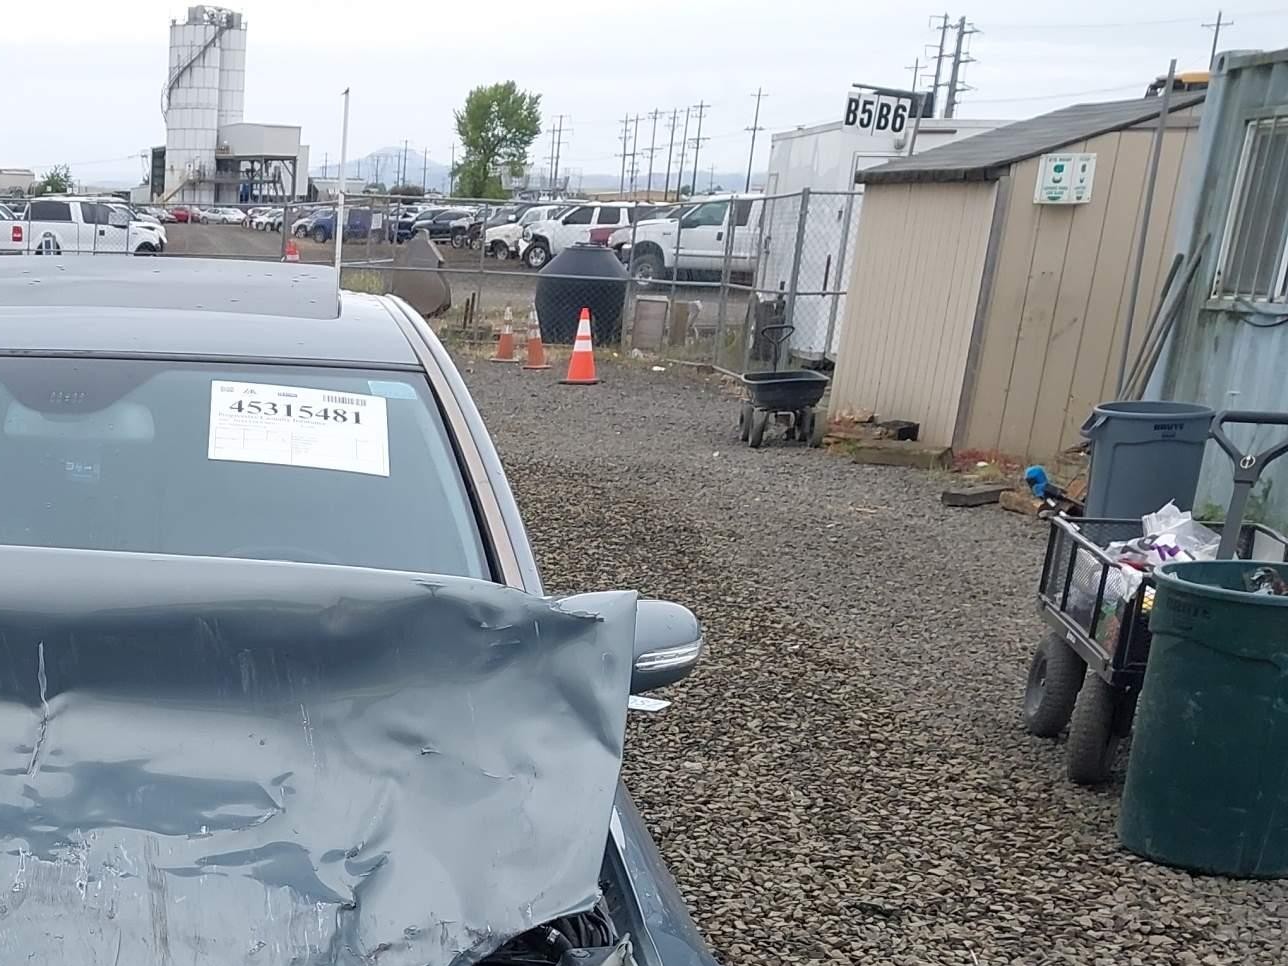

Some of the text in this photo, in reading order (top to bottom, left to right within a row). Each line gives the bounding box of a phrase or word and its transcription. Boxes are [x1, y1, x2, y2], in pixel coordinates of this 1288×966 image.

[844, 97, 907, 133] B5 B6
[229, 399, 361, 425] 45315481
